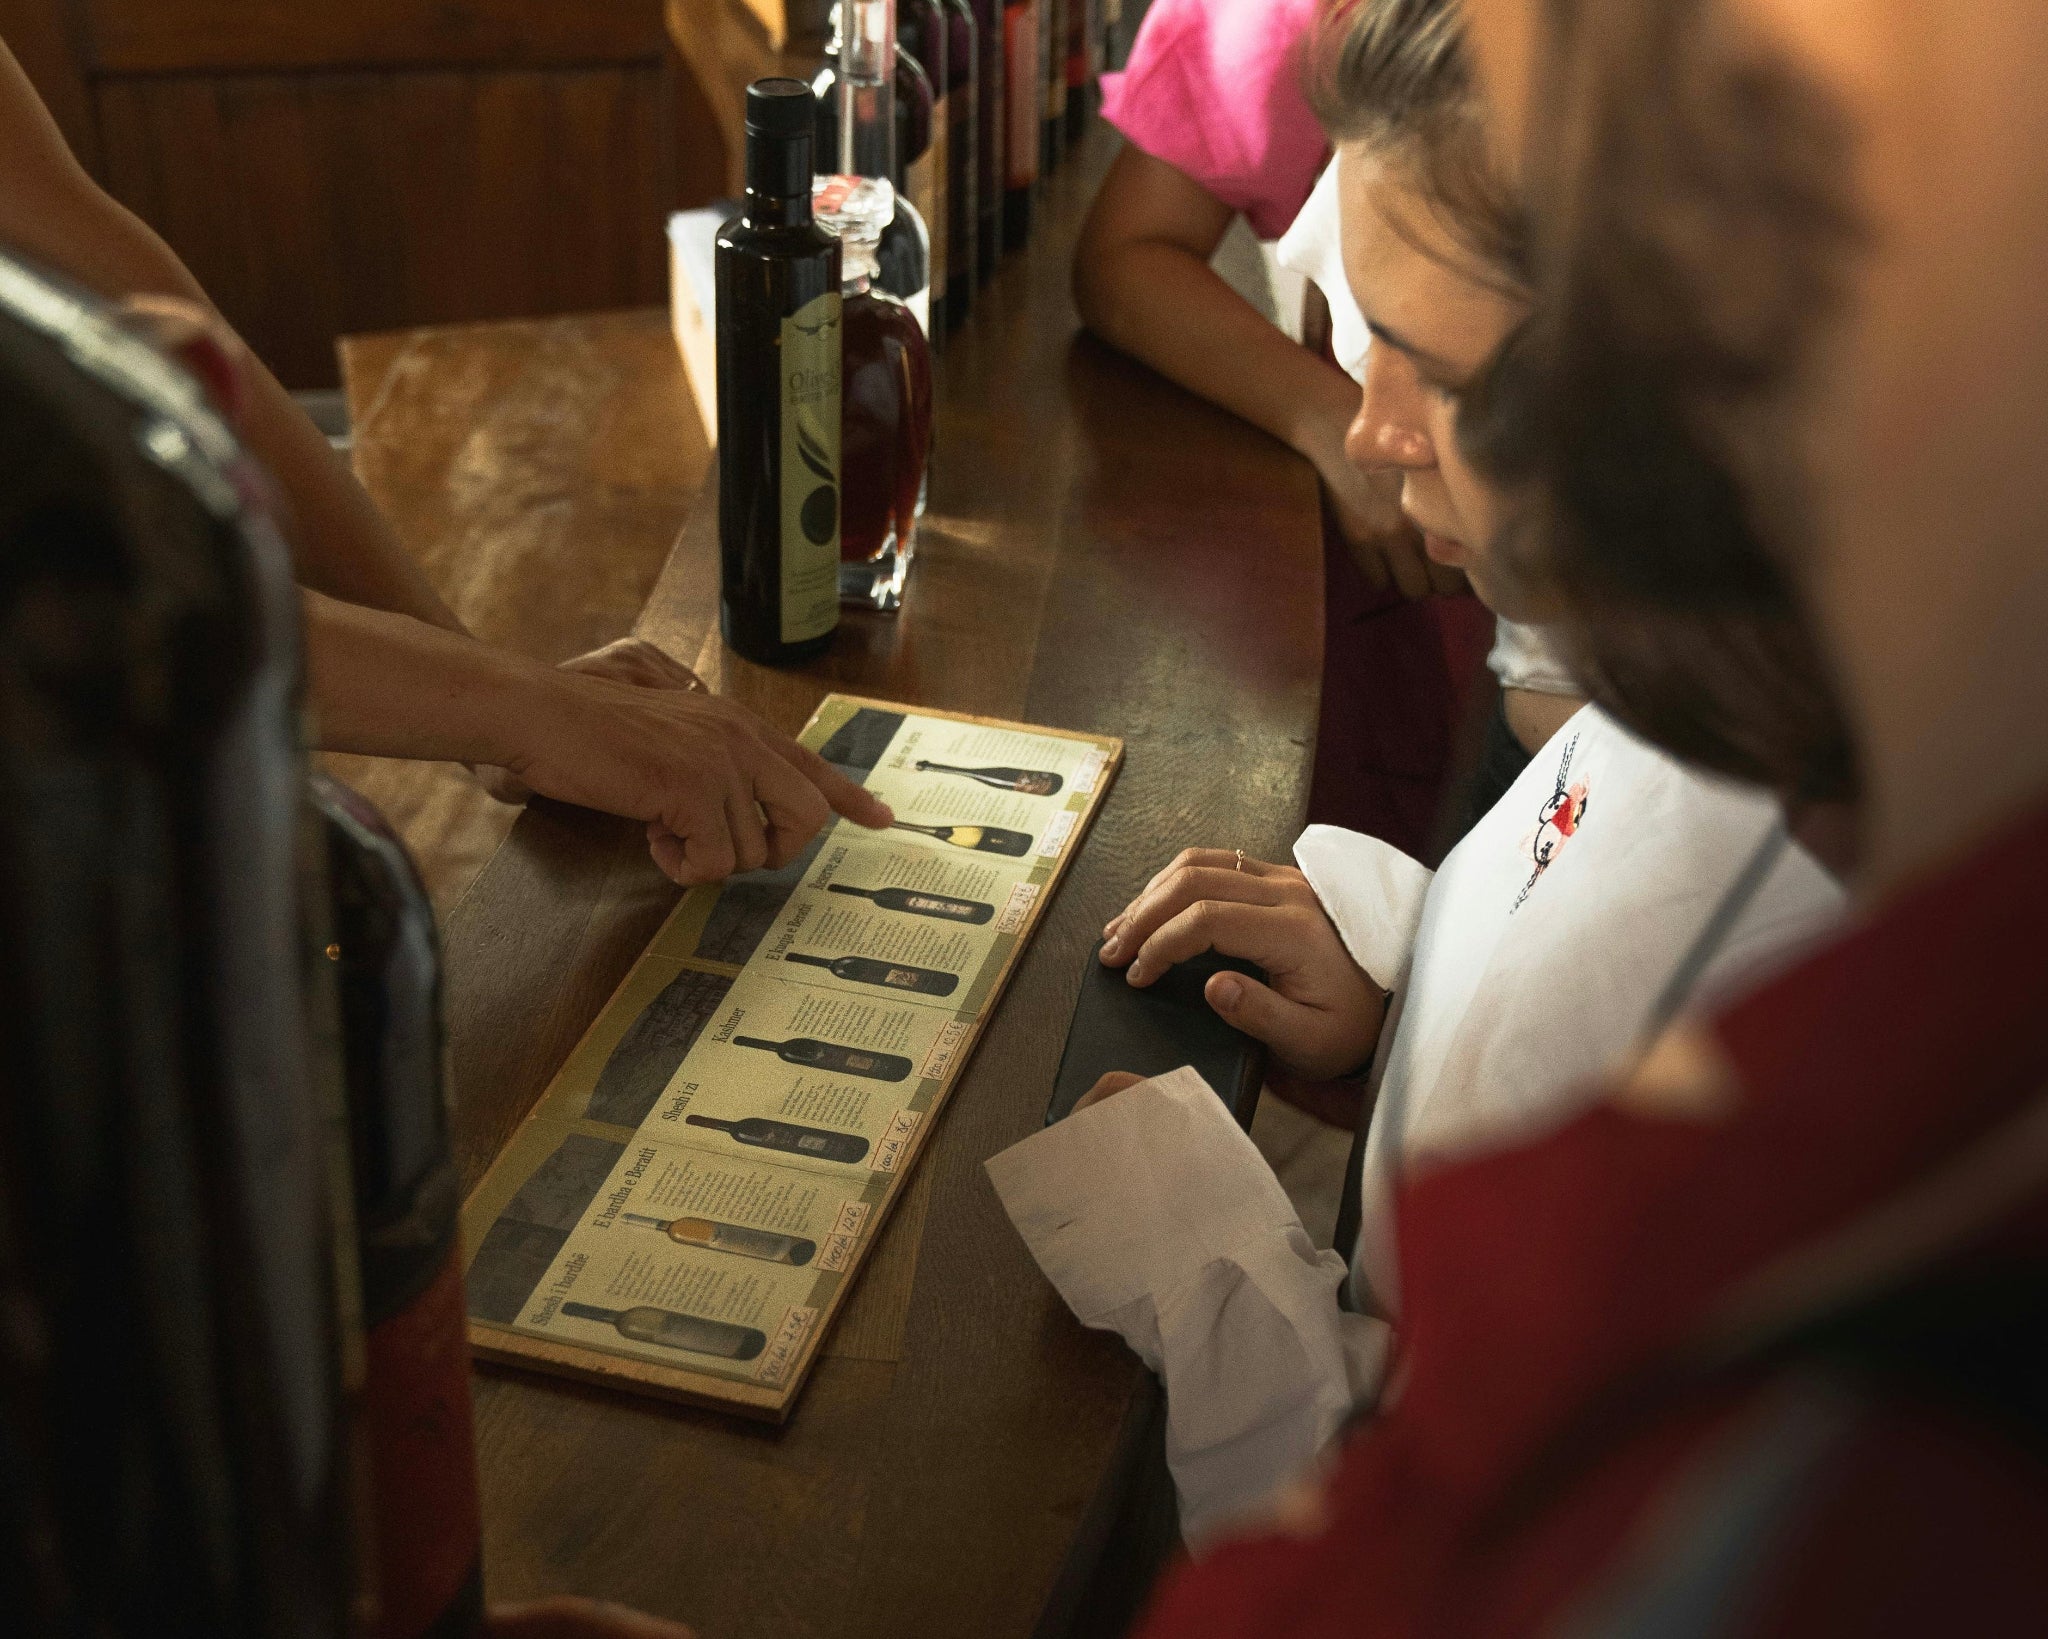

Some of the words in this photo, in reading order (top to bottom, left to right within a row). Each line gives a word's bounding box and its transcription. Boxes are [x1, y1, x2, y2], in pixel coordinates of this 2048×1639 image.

[765, 953, 781, 961] E
[711, 1007, 746, 1043] Kashmer
[661, 1096, 691, 1122] Shesh
[682, 1081, 700, 1091] zi
[624, 1147, 658, 1178] Beratit
[596, 1187, 633, 1220] bardha
[592, 1219, 612, 1229] E
[530, 1295, 563, 1326] Shesh
[553, 1252, 590, 1288] bardhë
